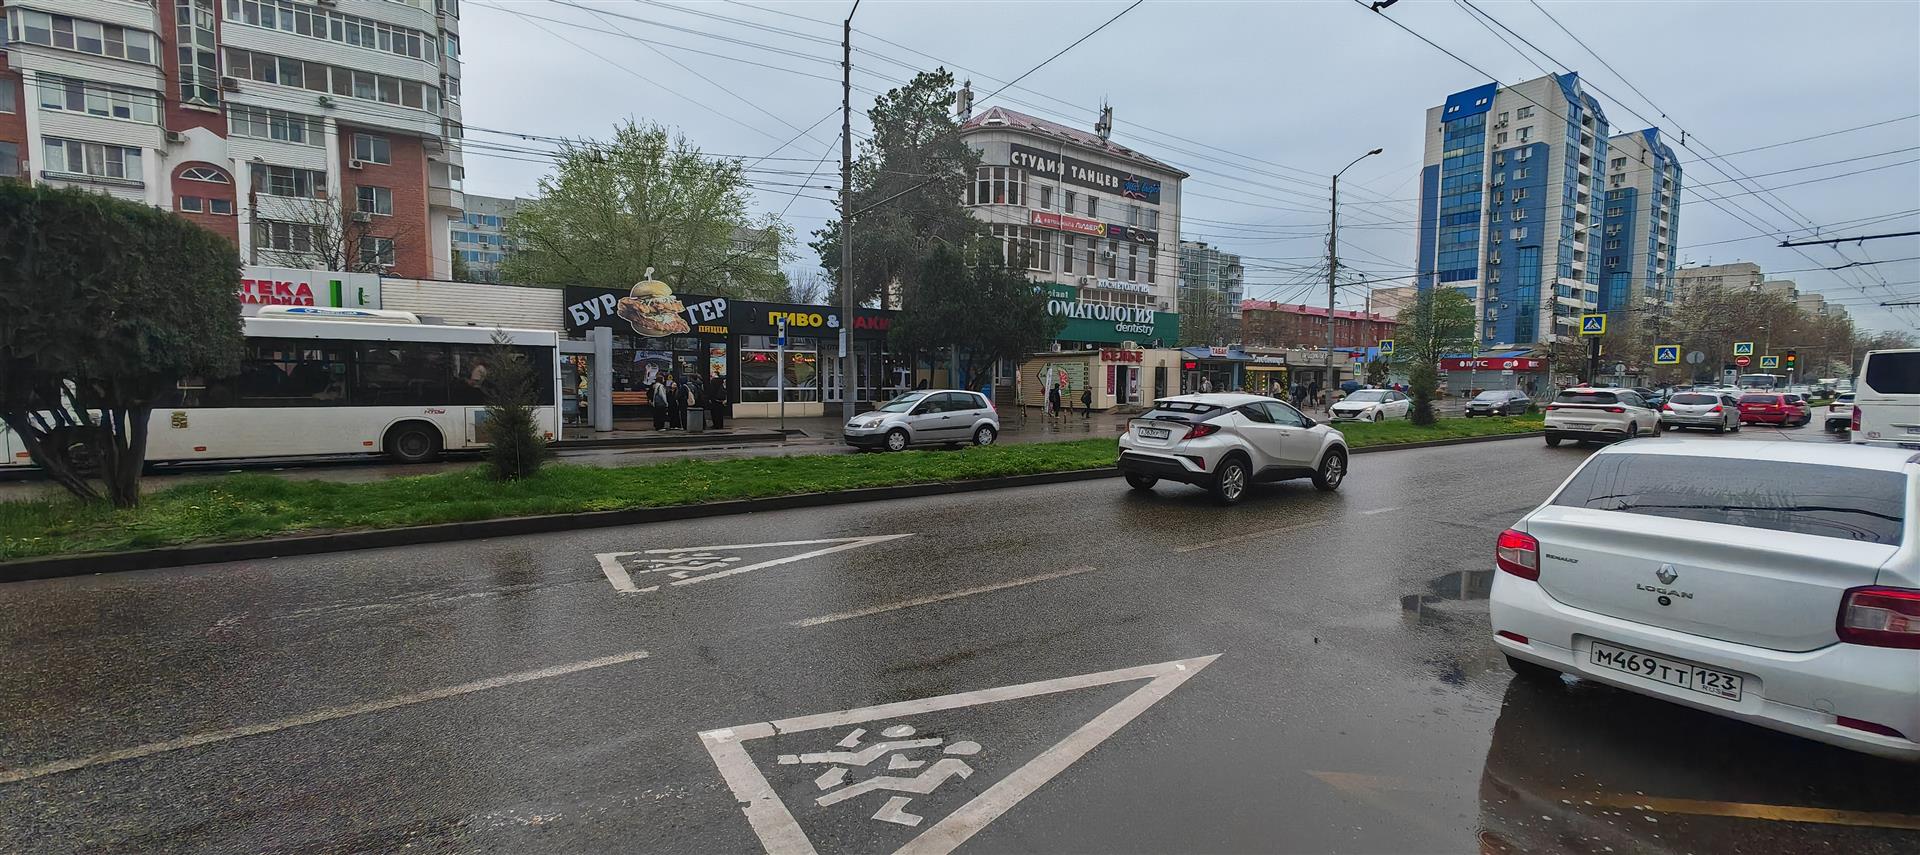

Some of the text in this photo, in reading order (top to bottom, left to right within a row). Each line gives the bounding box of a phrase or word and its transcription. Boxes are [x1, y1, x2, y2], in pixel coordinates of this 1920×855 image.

[1011, 151, 1119, 188] СТУДИЯ ТАНЦЕВ
[240, 279, 314, 298] ТЕКА
[1097, 279, 1150, 293] КОСМЕТОЛОГИЯ
[240, 294, 315, 306] АЛЬНАЯ
[568, 293, 727, 326] БУР ГЕР
[1047, 299, 1155, 324] ОМАТОЛОГИЯ
[768, 311, 892, 330] ПИВО & АКИ
[698, 325, 729, 334] ПИЦЦА
[1115, 322, 1154, 336] dentistry
[1101, 350, 1143, 363] БЕЛЬЕ
[1546, 553, 1579, 564] RENAULT
[1637, 583, 1693, 600] LOGAN
[1597, 649, 1737, 690] М469ТТ 123
[1702, 684, 1722, 695] RUS
